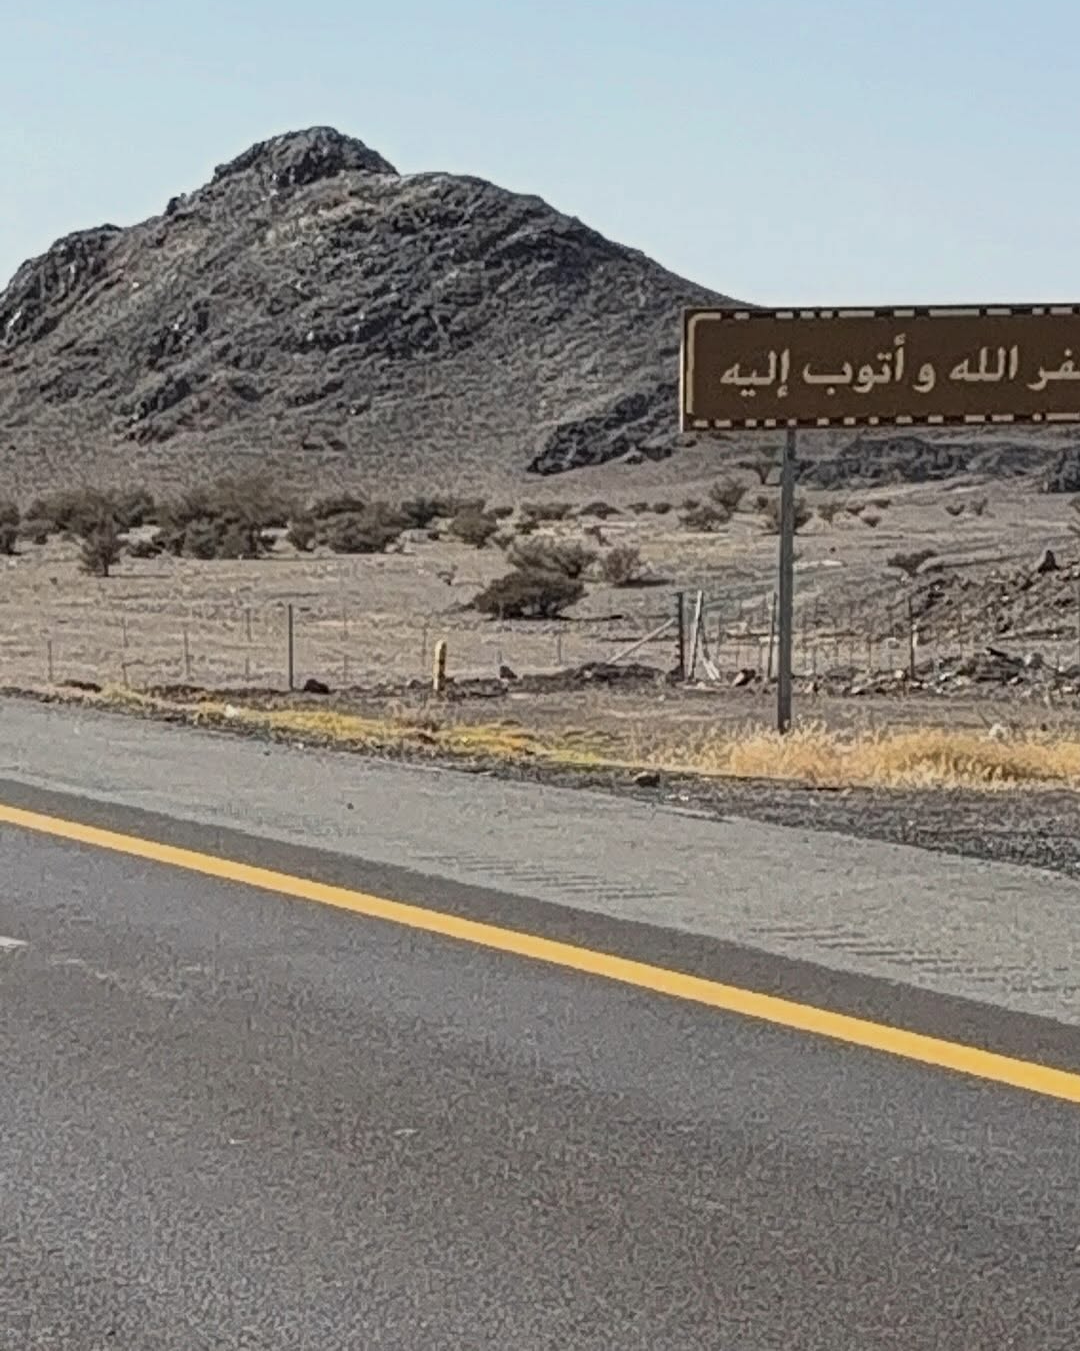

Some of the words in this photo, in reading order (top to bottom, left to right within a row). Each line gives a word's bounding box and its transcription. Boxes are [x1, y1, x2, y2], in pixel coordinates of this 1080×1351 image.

[719, 348, 791, 399] إليه
[802, 332, 907, 397] أتوب
[948, 344, 1019, 382] الله
